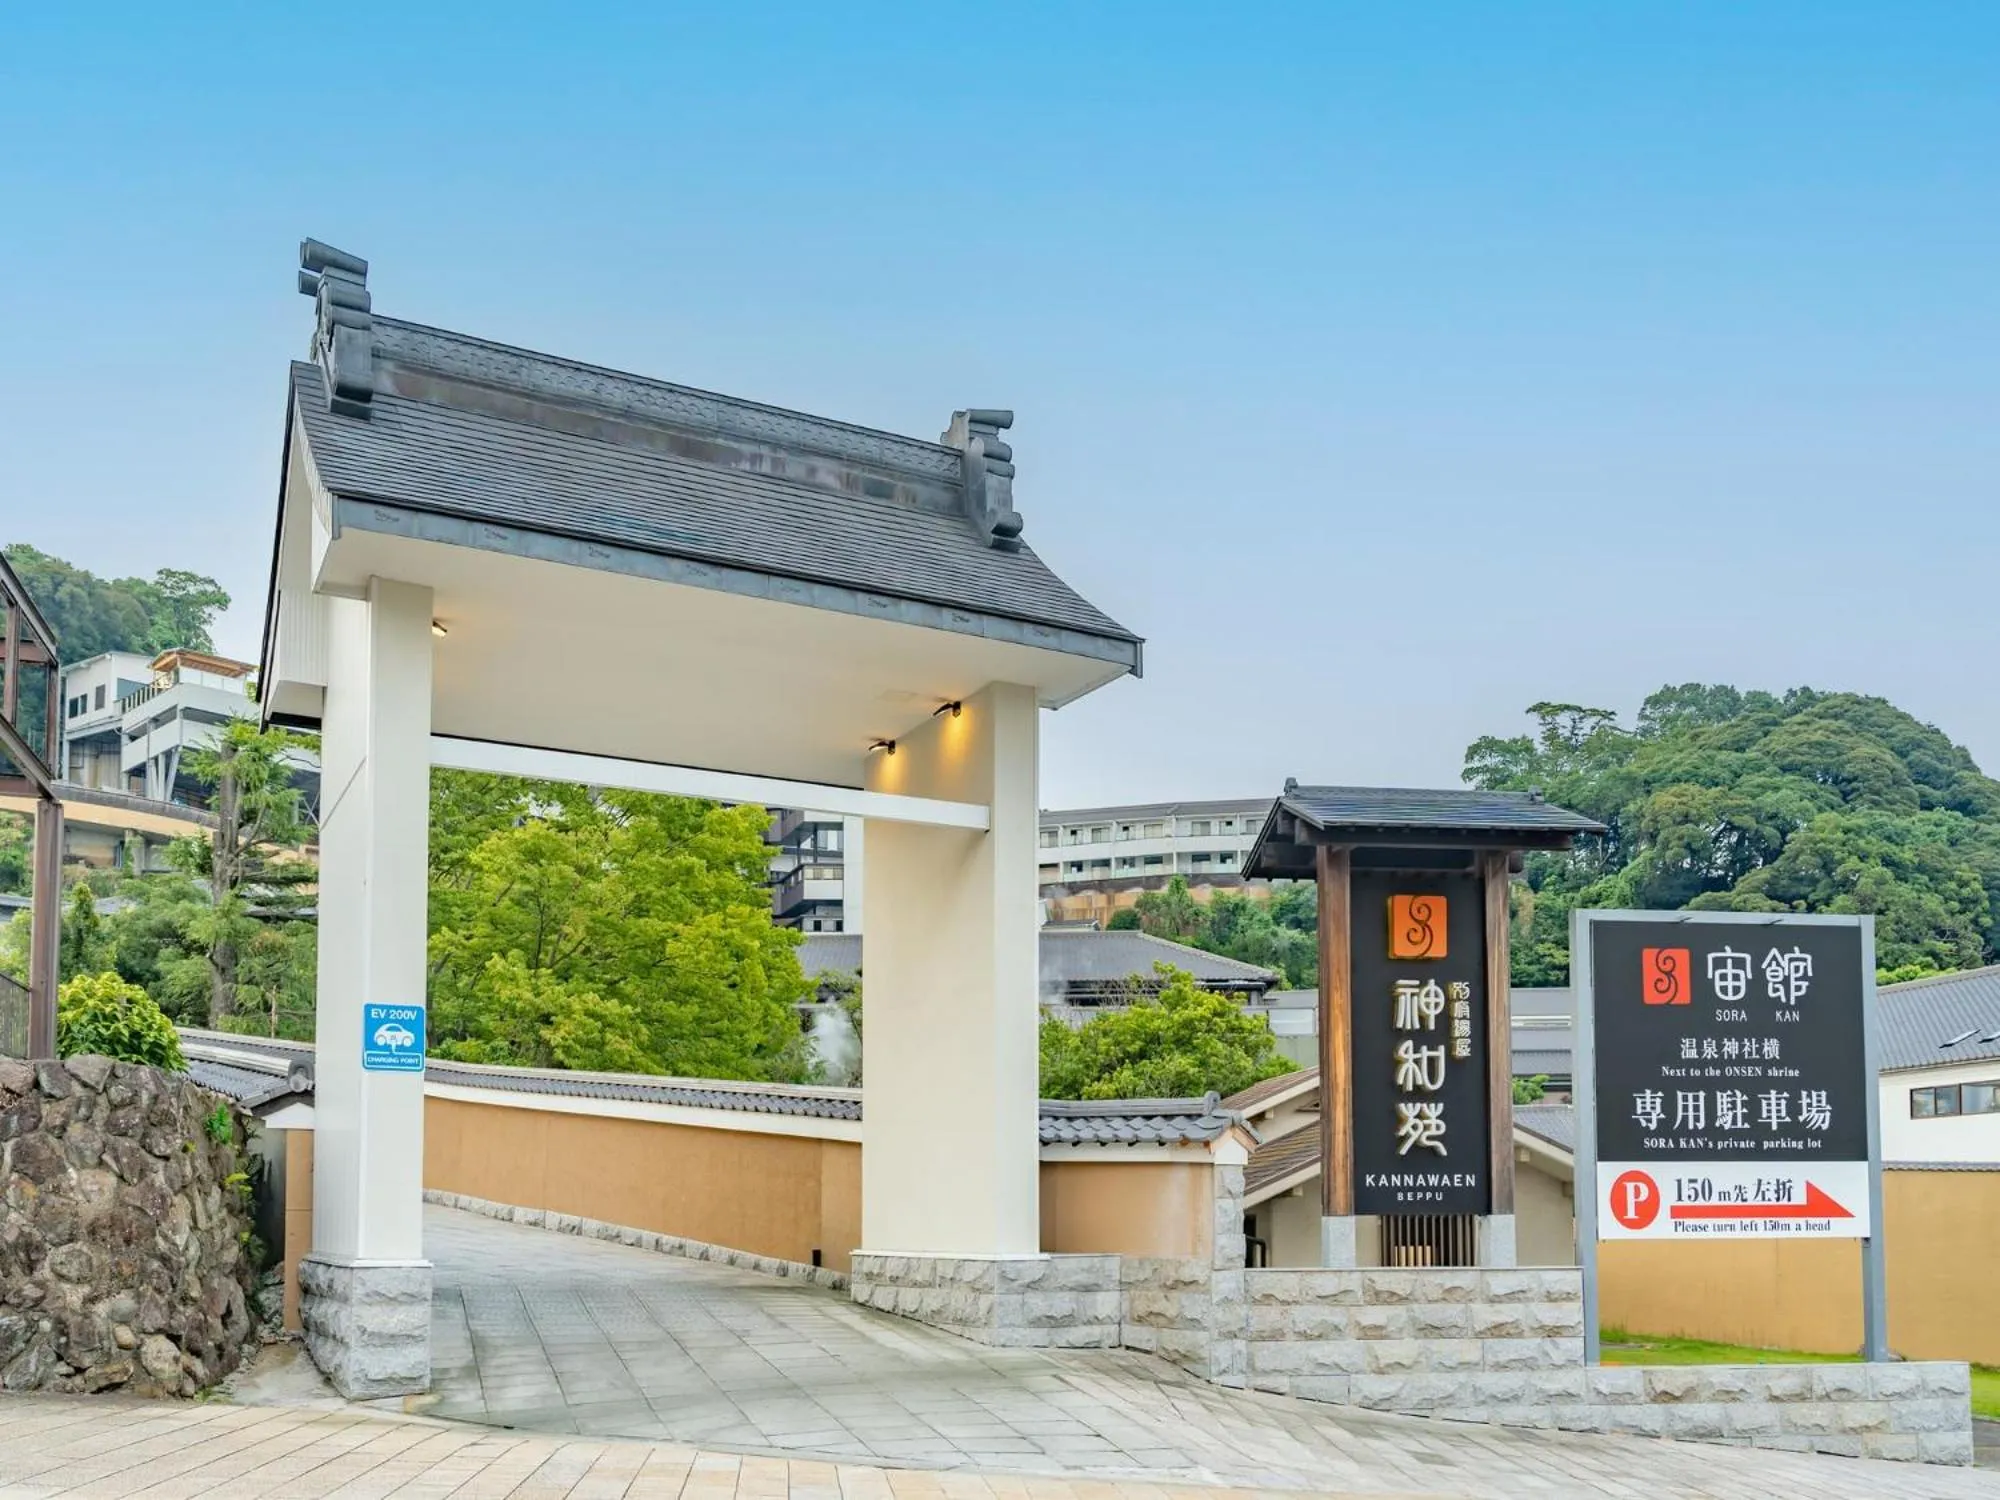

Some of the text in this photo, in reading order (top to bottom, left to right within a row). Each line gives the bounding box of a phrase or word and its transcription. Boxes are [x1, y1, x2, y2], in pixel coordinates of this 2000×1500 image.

[371, 1008, 417, 1020] EV 200V
[1715, 1009, 1800, 1022] SORA KAN
[1680, 1037, 1781, 1060] 温泉神社横
[401, 1057, 418, 1065] POINT
[1395, 979, 1447, 1156] 神和苑
[1661, 1066, 1800, 1077] Next to the ONSEN shrine
[1631, 1088, 1832, 1131] 専用駐車場
[1643, 1138, 1822, 1150] SORA KAN's private parking lot
[1365, 1173, 1476, 1187] KANNAWAEN
[1397, 1192, 1443, 1201] BEPPU
[1622, 1181, 1649, 1219] P
[1674, 1220, 1709, 1233] Please
[1712, 1221, 1736, 1232] turn
[1740, 1220, 1758, 1232] left
[1763, 1220, 1790, 1231] 150m
[1805, 1219, 1831, 1231] head
